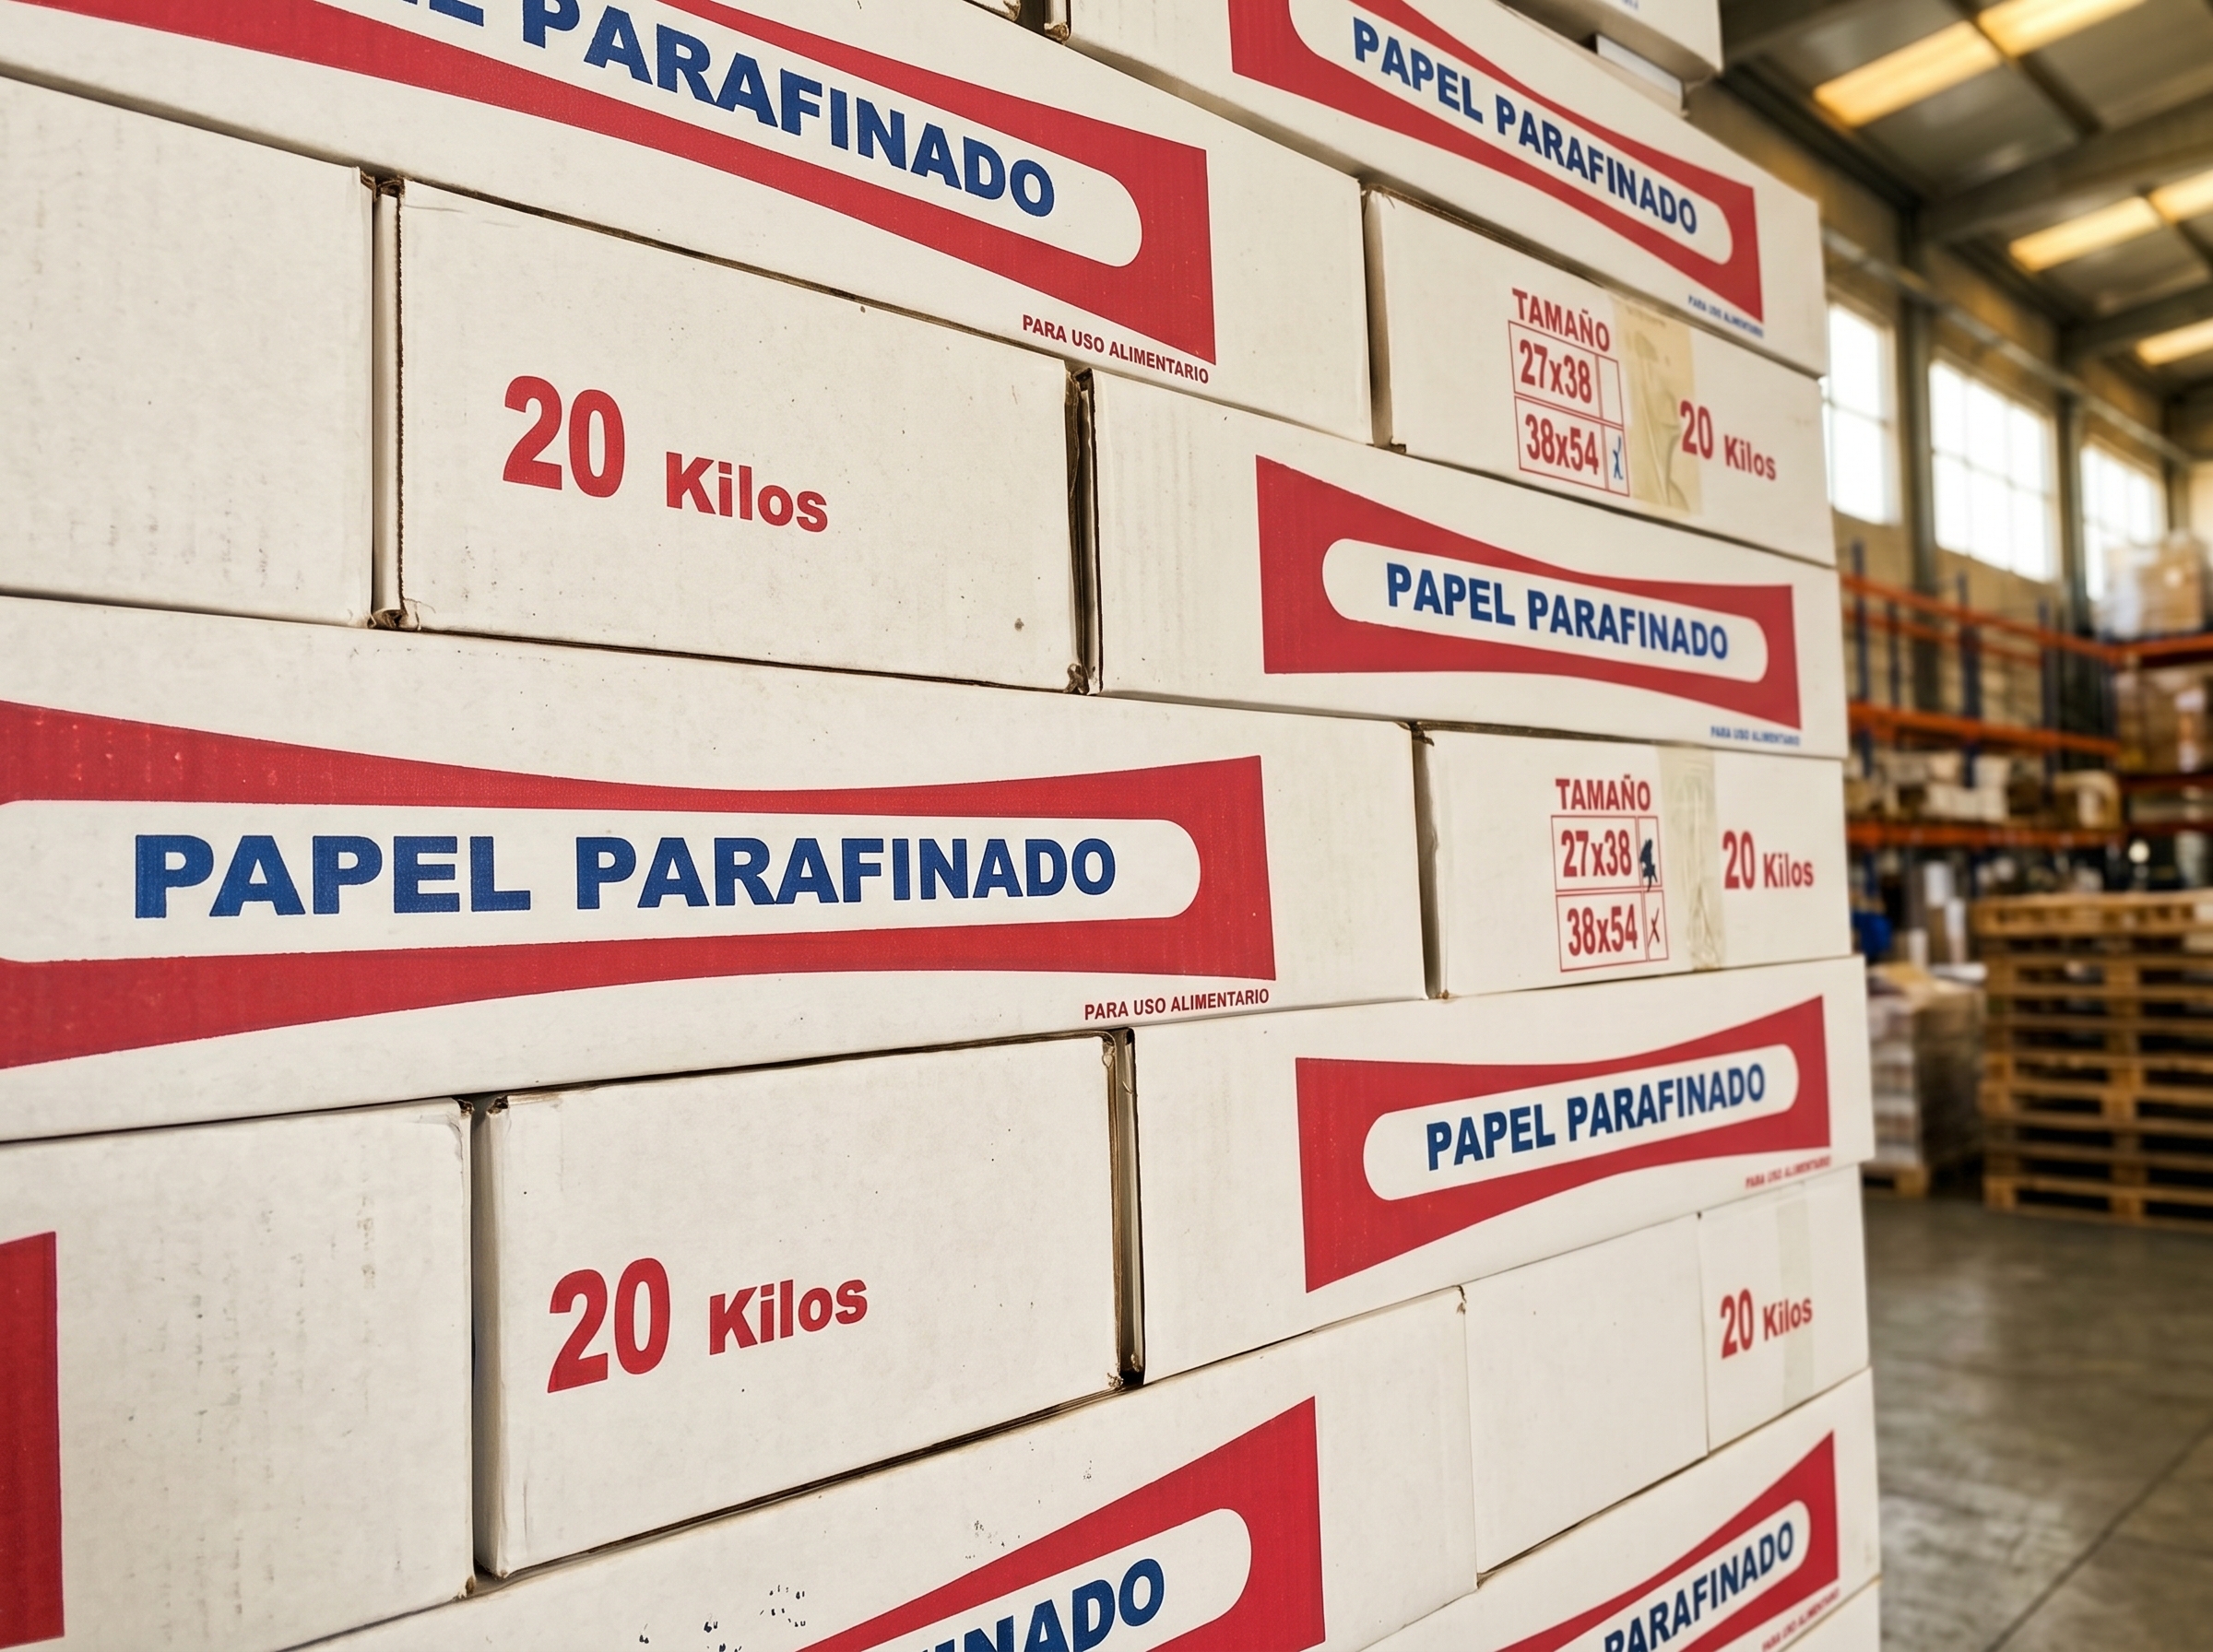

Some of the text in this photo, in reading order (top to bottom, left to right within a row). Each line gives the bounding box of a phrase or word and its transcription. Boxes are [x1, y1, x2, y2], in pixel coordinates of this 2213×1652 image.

[521, 0, 1056, 218] PARAFINADO
[1352, 17, 1698, 235] PAPEL PARAFINADO
[1023, 314, 1209, 384] PARA USO ALIMENTARIO
[1512, 288, 1610, 352] TAMAÑO
[1520, 339, 1592, 404] 27x38
[503, 375, 828, 533] 20 Kilos
[1525, 413, 1599, 475] 38x54
[1680, 399, 1777, 481] 20 Kilos
[1386, 561, 1729, 661] PAPEL PARAFINADO
[1555, 774, 1651, 811] TAMAÑO
[134, 832, 1118, 921] PAPEL PARAFINADO
[1561, 830, 1632, 878] 27x38
[1722, 831, 1814, 890] 20 Kilos
[1568, 903, 1639, 956] 38x54
[1084, 988, 1270, 1021] PARA USO ALIMENTARIO
[1426, 1062, 1767, 1172] PAPEL PARAFINADO
[548, 1257, 868, 1393] 20 Kilos
[1721, 1289, 1813, 1359] 20 Kilos
